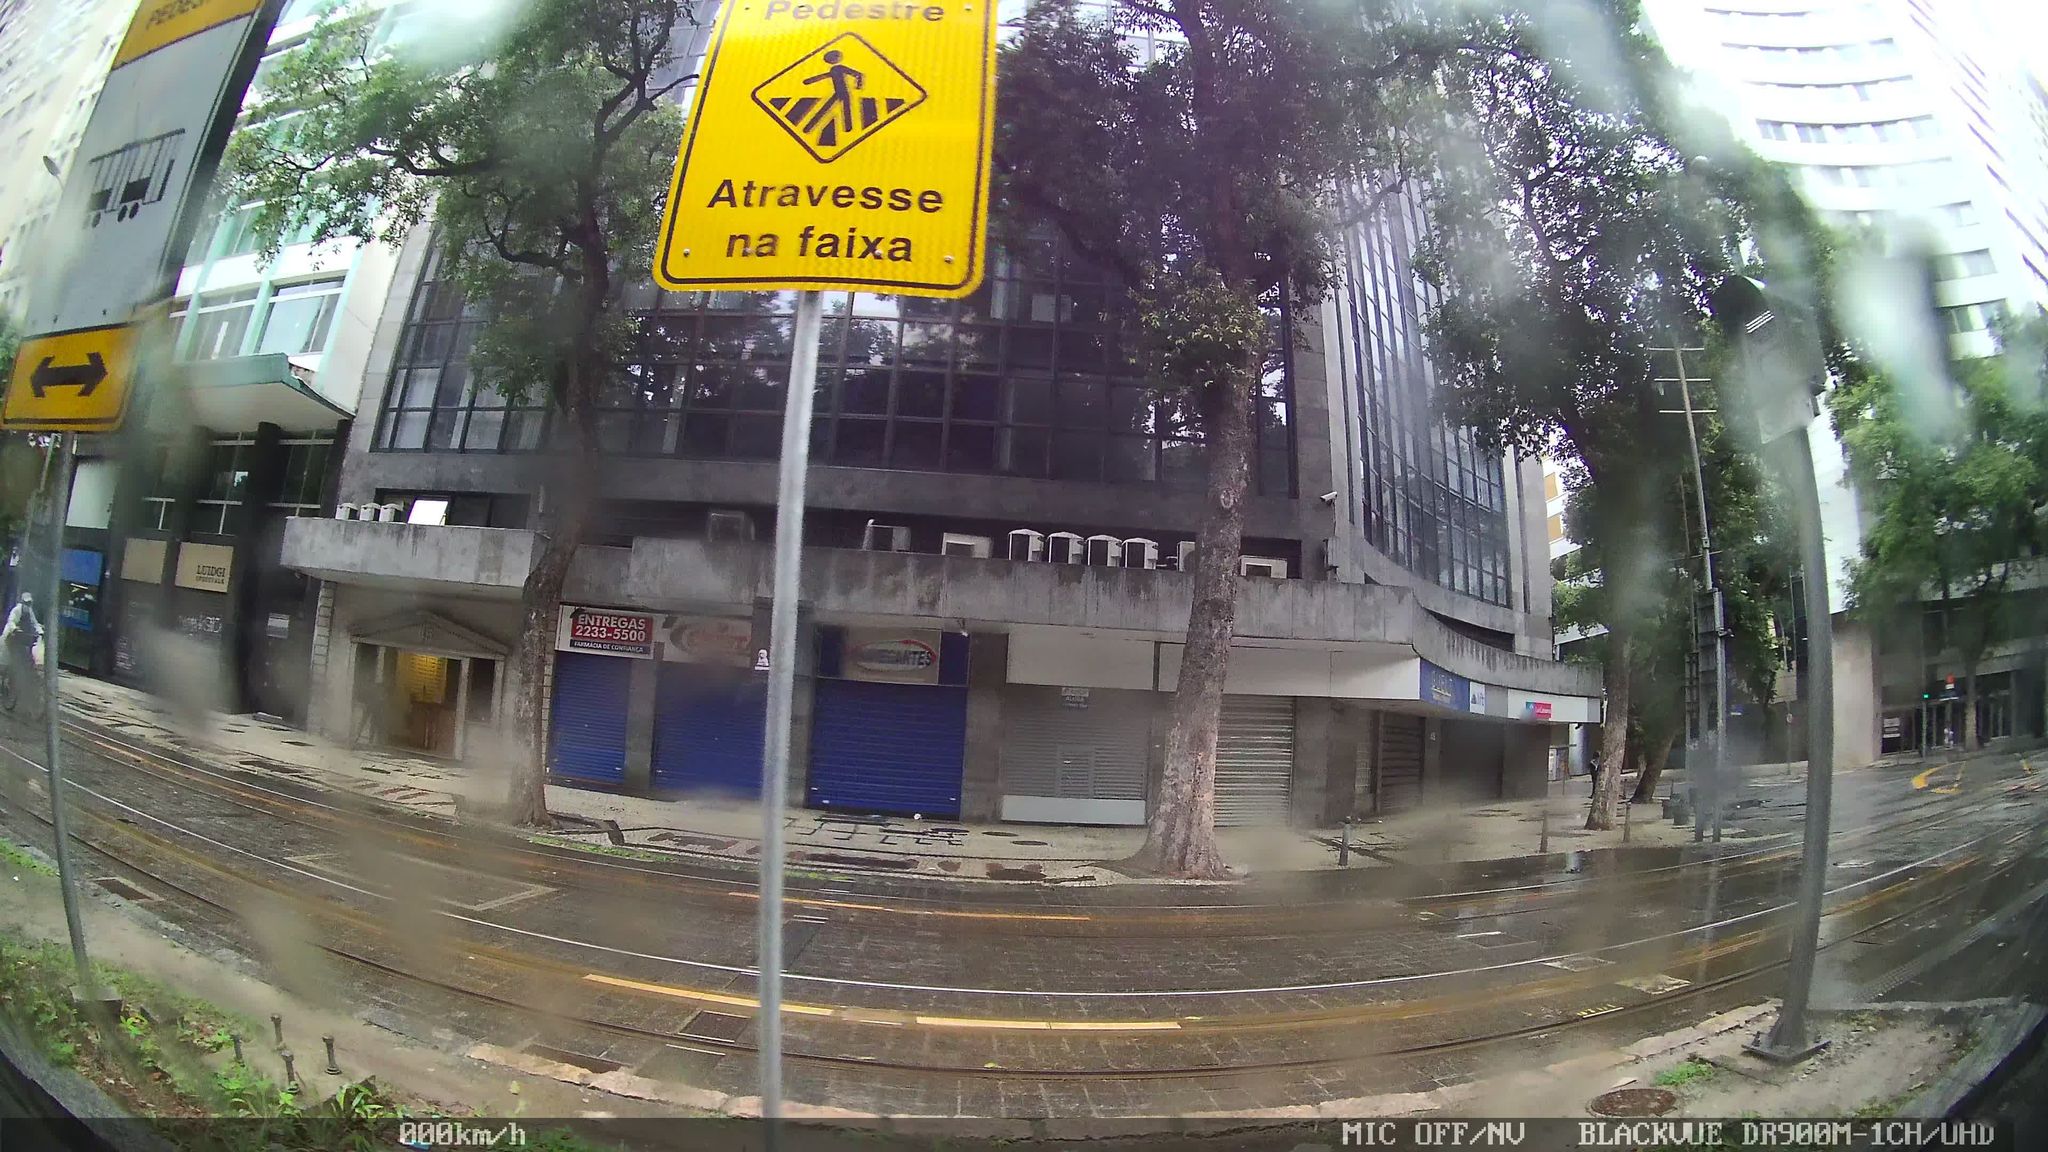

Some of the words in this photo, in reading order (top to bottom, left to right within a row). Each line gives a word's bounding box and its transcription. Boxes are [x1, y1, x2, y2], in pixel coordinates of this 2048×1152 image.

[764, 0, 944, 22] Pedestre
[707, 179, 943, 213] Atravesse
[726, 233, 779, 258] na
[798, 226, 912, 262] faixa
[575, 625, 646, 641] 2233-5500
[579, 614, 646, 630] ENTREGAS
